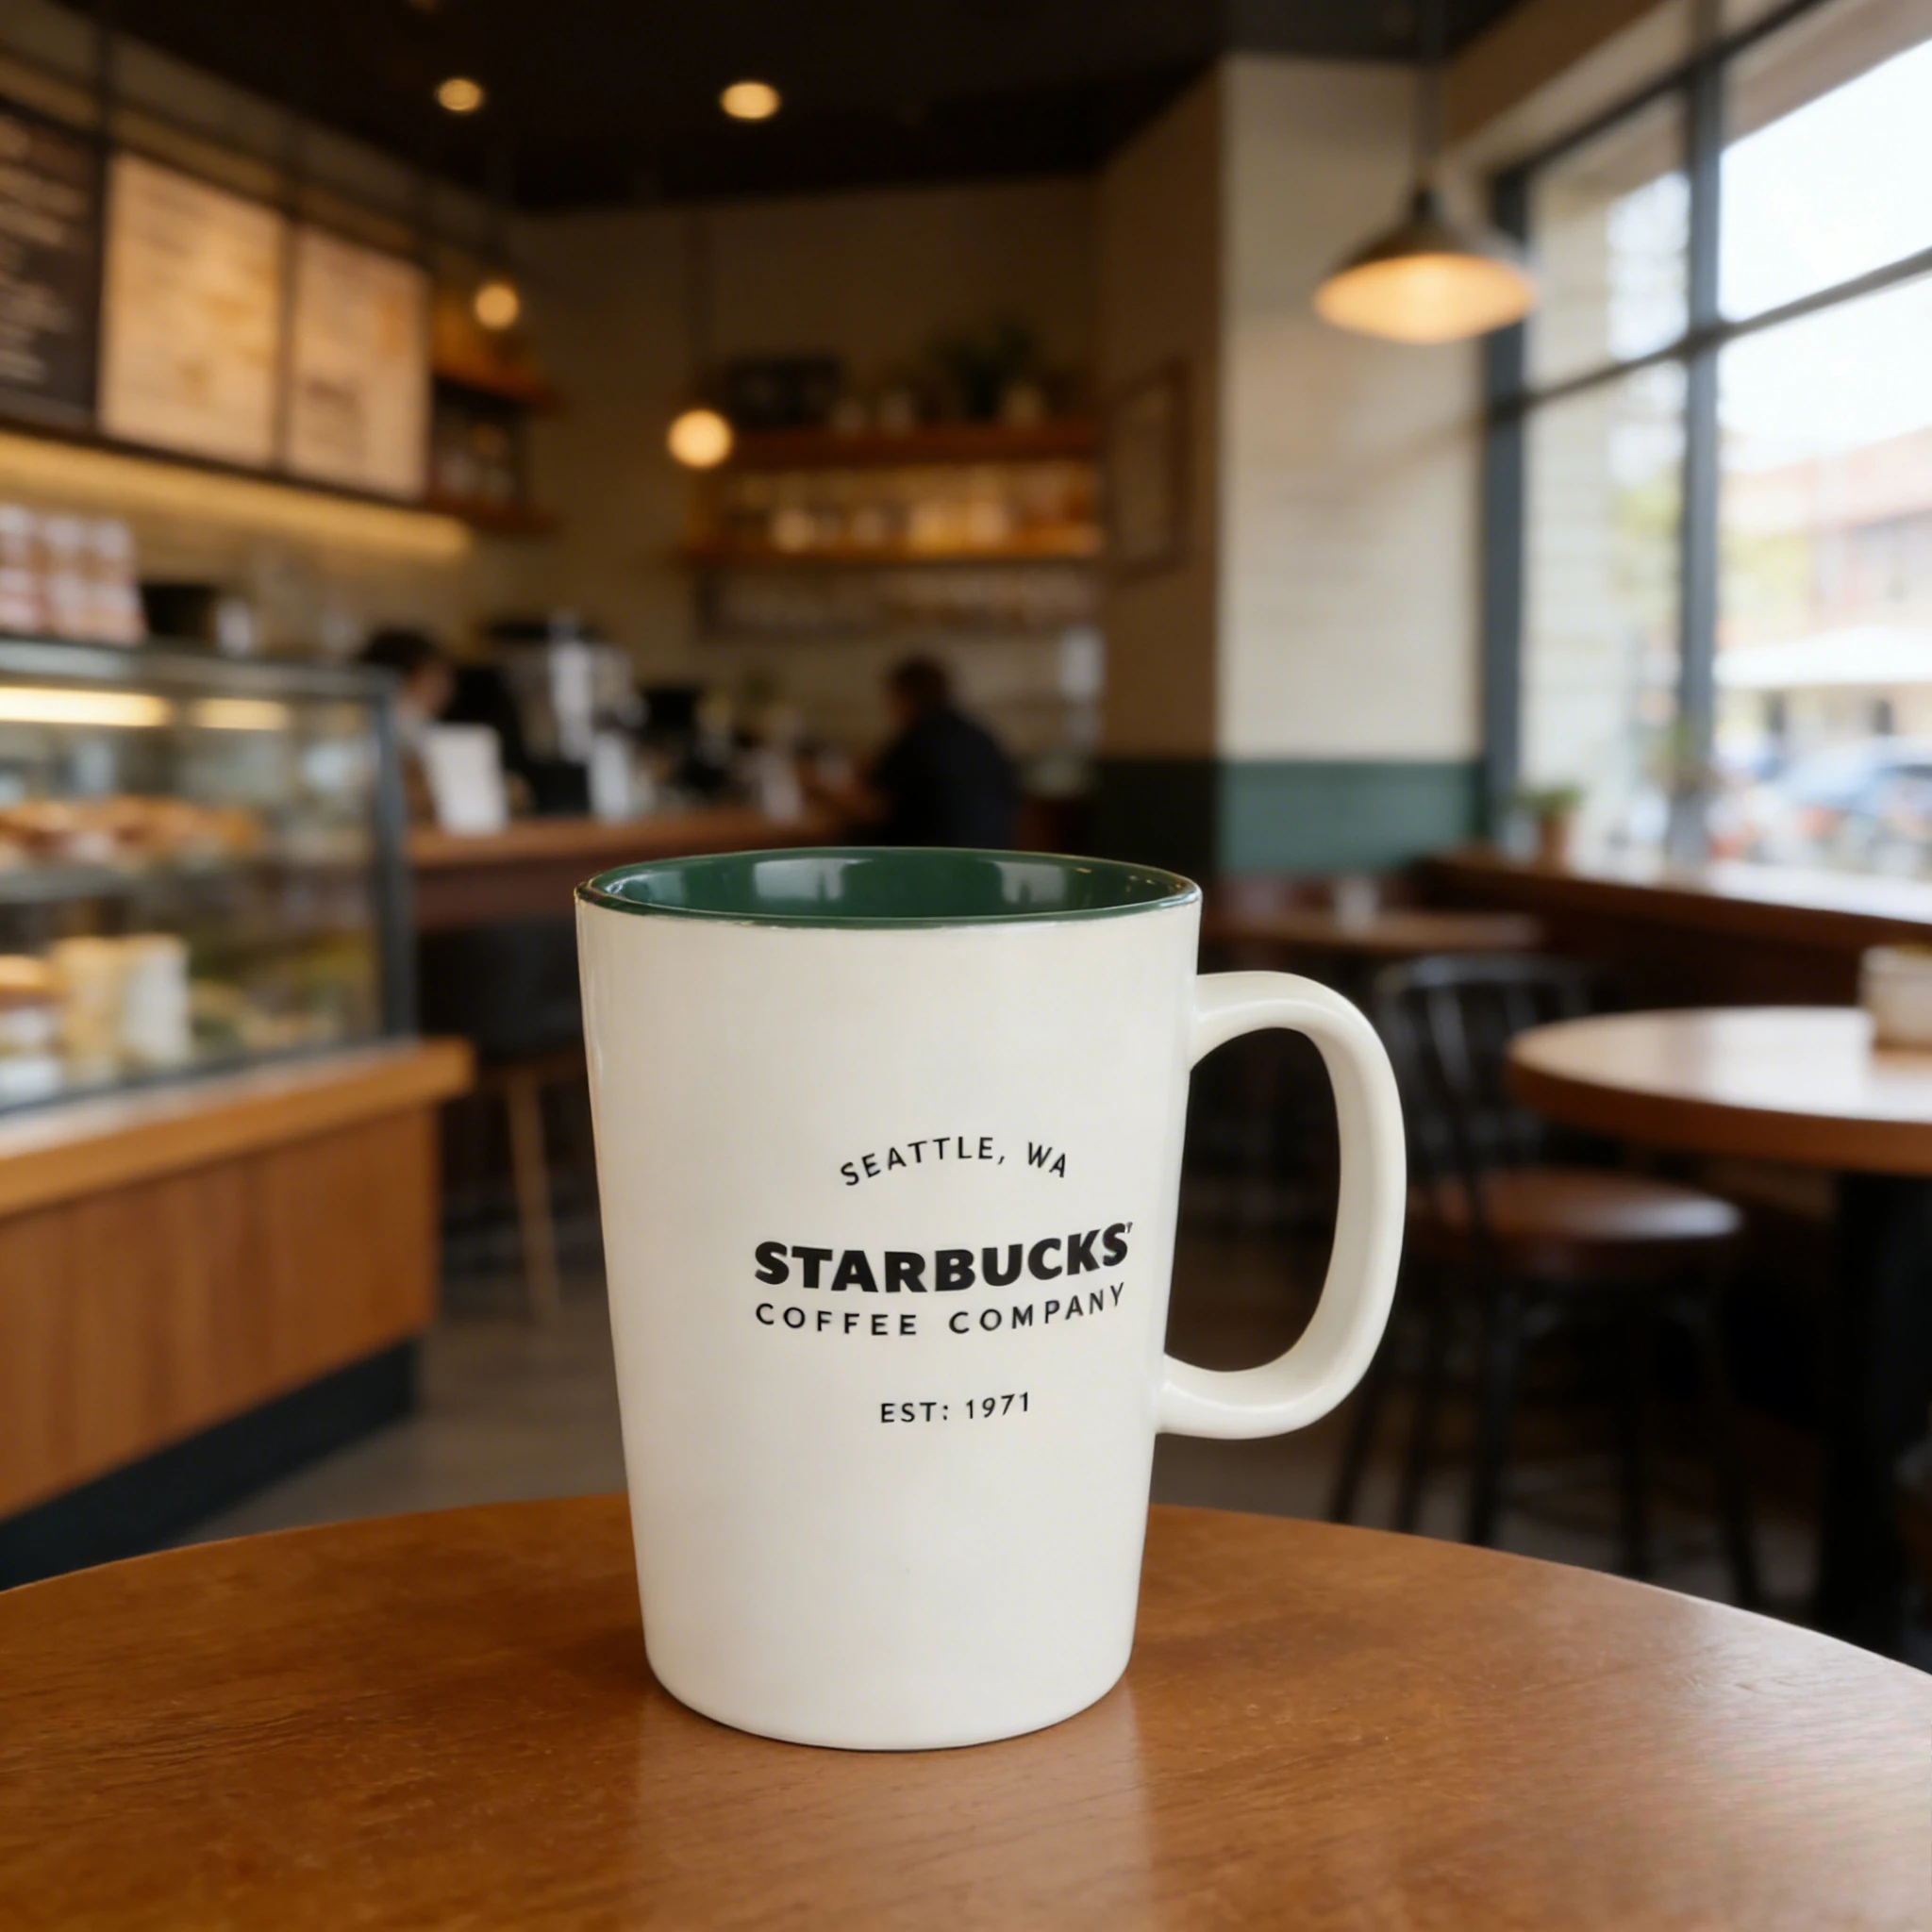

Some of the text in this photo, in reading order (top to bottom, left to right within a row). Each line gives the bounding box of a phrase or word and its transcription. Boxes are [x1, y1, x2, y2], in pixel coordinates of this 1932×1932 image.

[840, 1136, 1067, 1187] SEATTLE, WA
[755, 1282, 1125, 1336] COFFEE COMPANY
[880, 1391, 1029, 1424] EST: 1971
